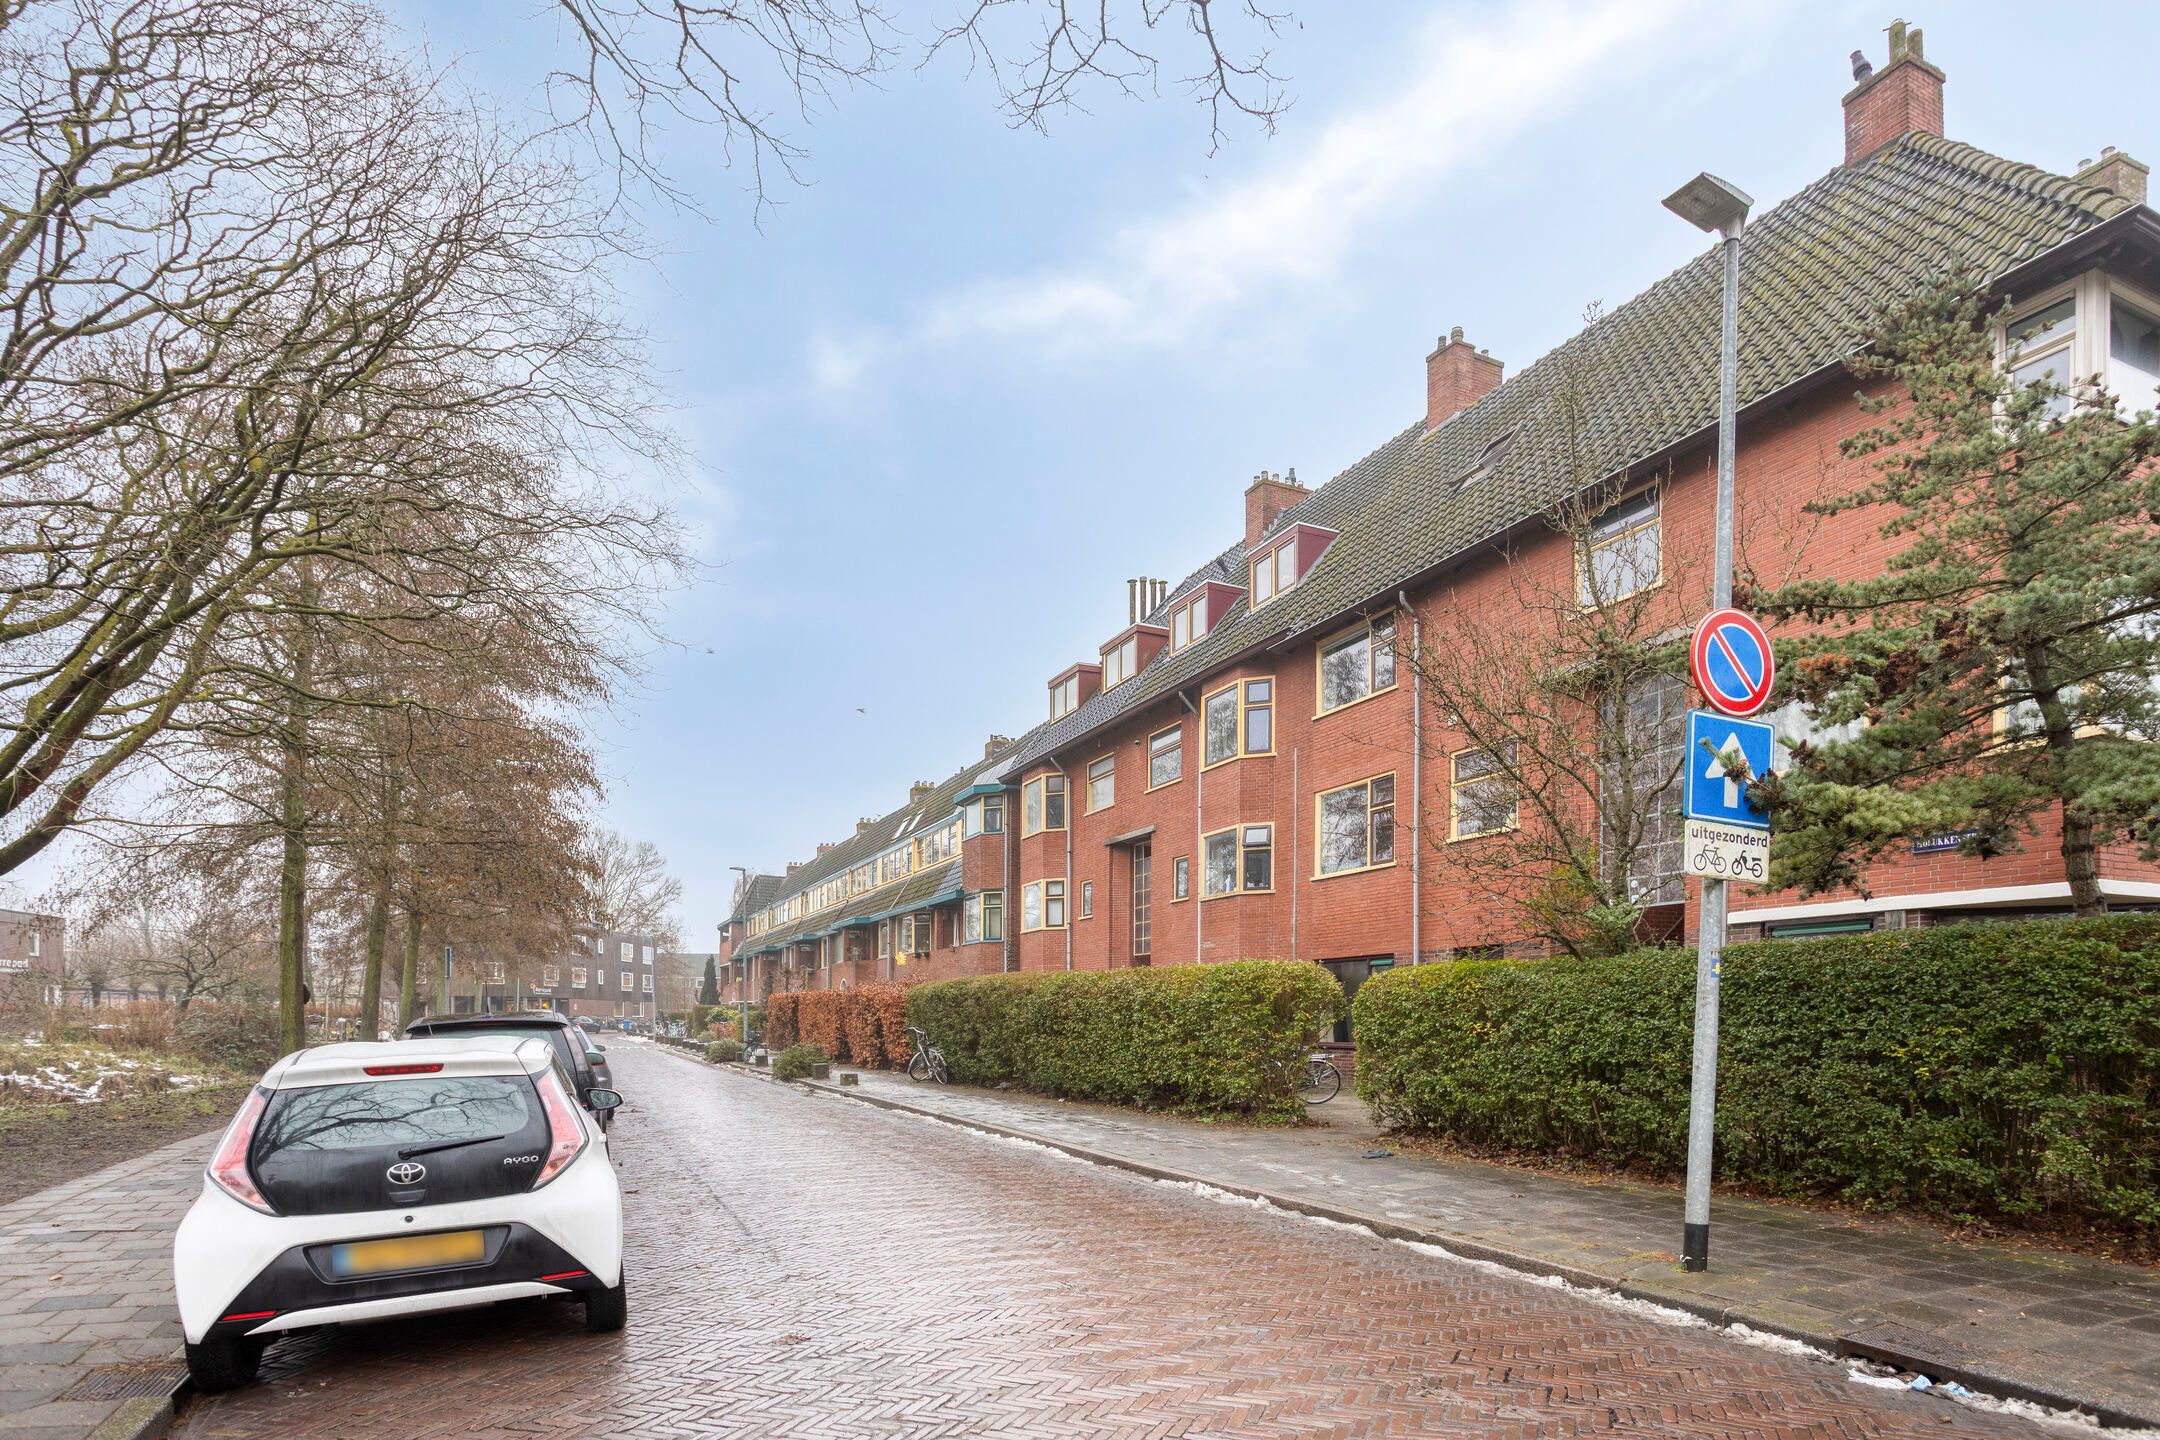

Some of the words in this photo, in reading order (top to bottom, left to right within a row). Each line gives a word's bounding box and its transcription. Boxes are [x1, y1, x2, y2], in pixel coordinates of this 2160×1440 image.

[1691, 826, 1768, 848] uitgezonderd
[1916, 832, 1977, 848] OLUKKEN
[503, 1155, 539, 1165] AYGO
